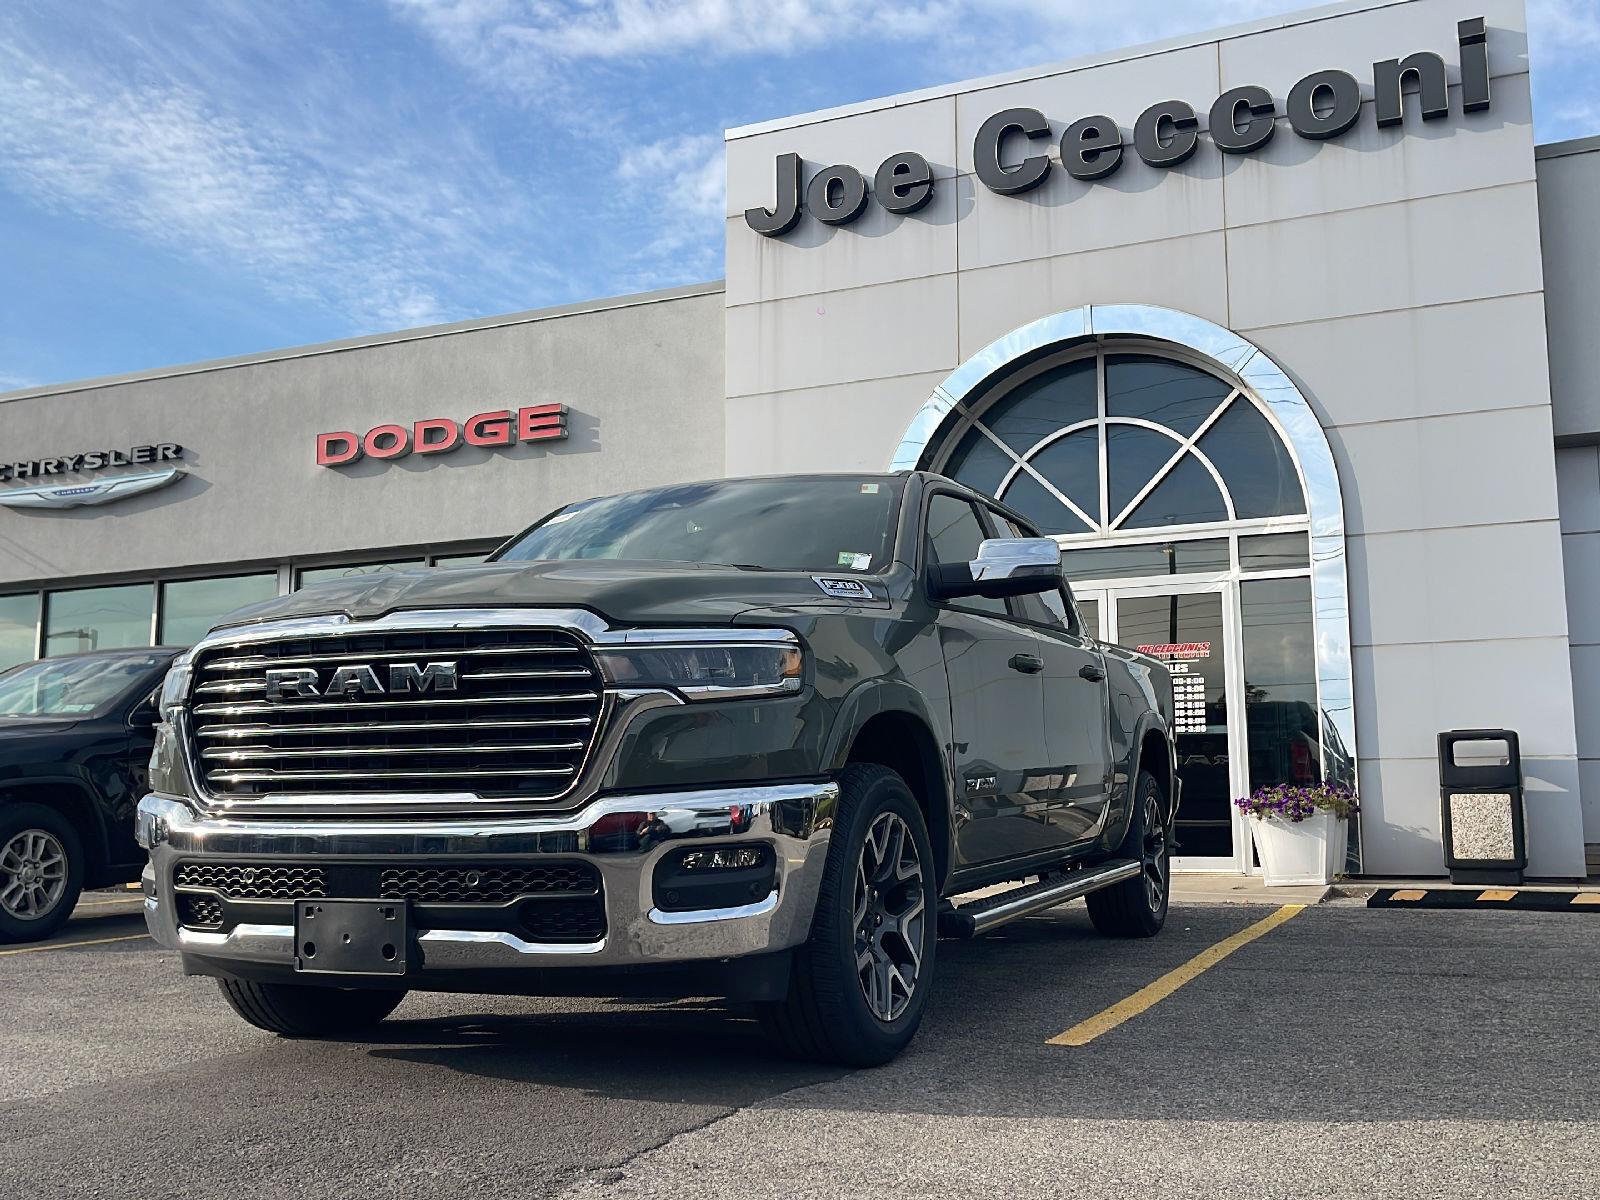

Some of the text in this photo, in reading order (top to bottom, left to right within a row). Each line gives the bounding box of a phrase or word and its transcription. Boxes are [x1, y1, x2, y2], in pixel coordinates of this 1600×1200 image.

[744, 17, 1491, 238] Joe Cecconi
[316, 402, 569, 467] DODGE
[822, 579, 861, 590] 1500
[266, 661, 458, 698] RAM
[1166, 664, 1189, 673] LES
